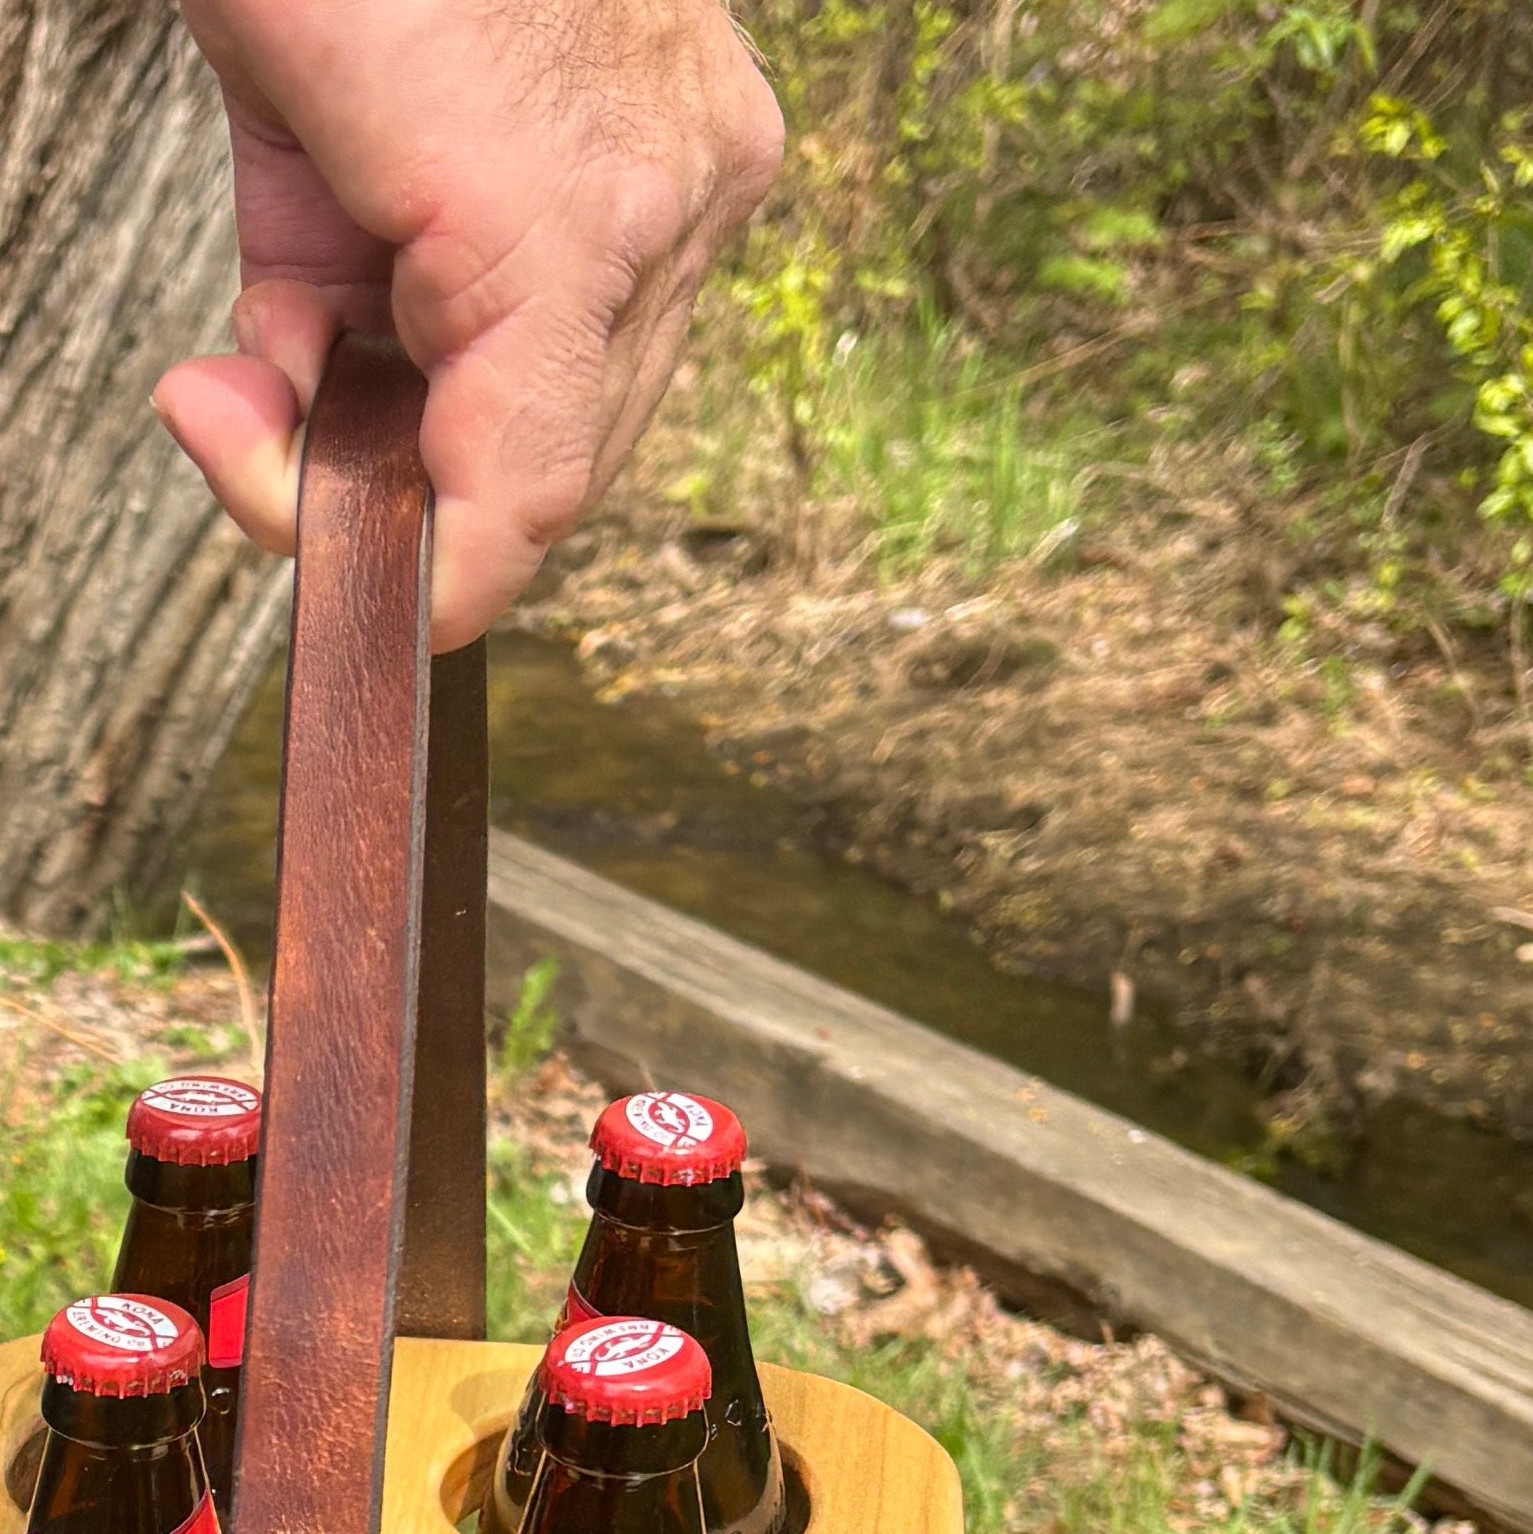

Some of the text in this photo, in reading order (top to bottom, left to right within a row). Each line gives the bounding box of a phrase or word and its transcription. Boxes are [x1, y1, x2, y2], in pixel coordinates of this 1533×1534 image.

[170, 1102, 218, 1113] KONA
[121, 1302, 165, 1325] KONA
[72, 1311, 122, 1344] BREWING
[621, 1347, 670, 1369] KONA
